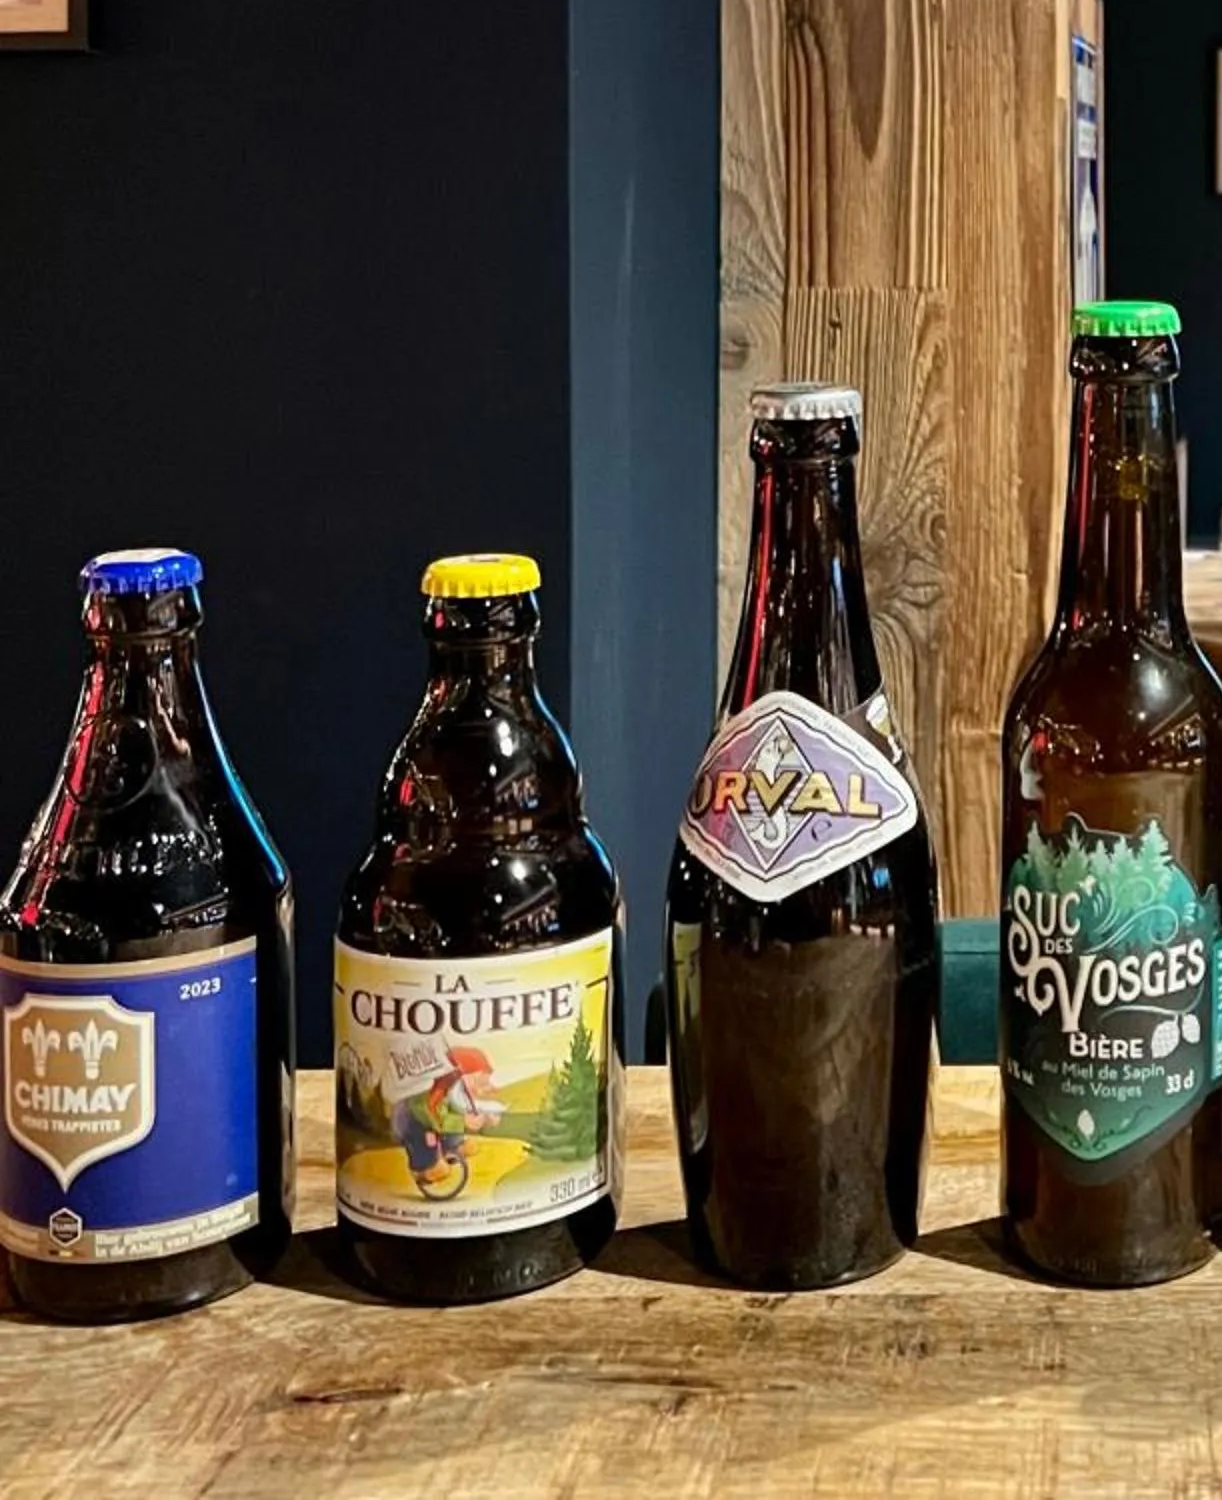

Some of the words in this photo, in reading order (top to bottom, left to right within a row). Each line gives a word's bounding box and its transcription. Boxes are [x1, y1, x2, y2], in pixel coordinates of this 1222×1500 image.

[1008, 884, 1080, 978] SUC
[1045, 937, 1073, 954] DES
[180, 977, 222, 1000] 2023
[435, 974, 470, 994] LA
[1027, 938, 1206, 1033] VOSGES
[350, 984, 575, 1035] CHOUFFE
[1069, 1032, 1144, 1059] BIÈRE
[1062, 1061, 1093, 1079] Miel
[1098, 1064, 1118, 1081] de
[1123, 1063, 1165, 1083] Sapin
[14, 1080, 137, 1113] CHIMAY
[1061, 1080, 1086, 1096] des
[1090, 1083, 1143, 1102] Vosges
[1165, 1074, 1182, 1095] 33
[550, 1177, 575, 1203] 330
